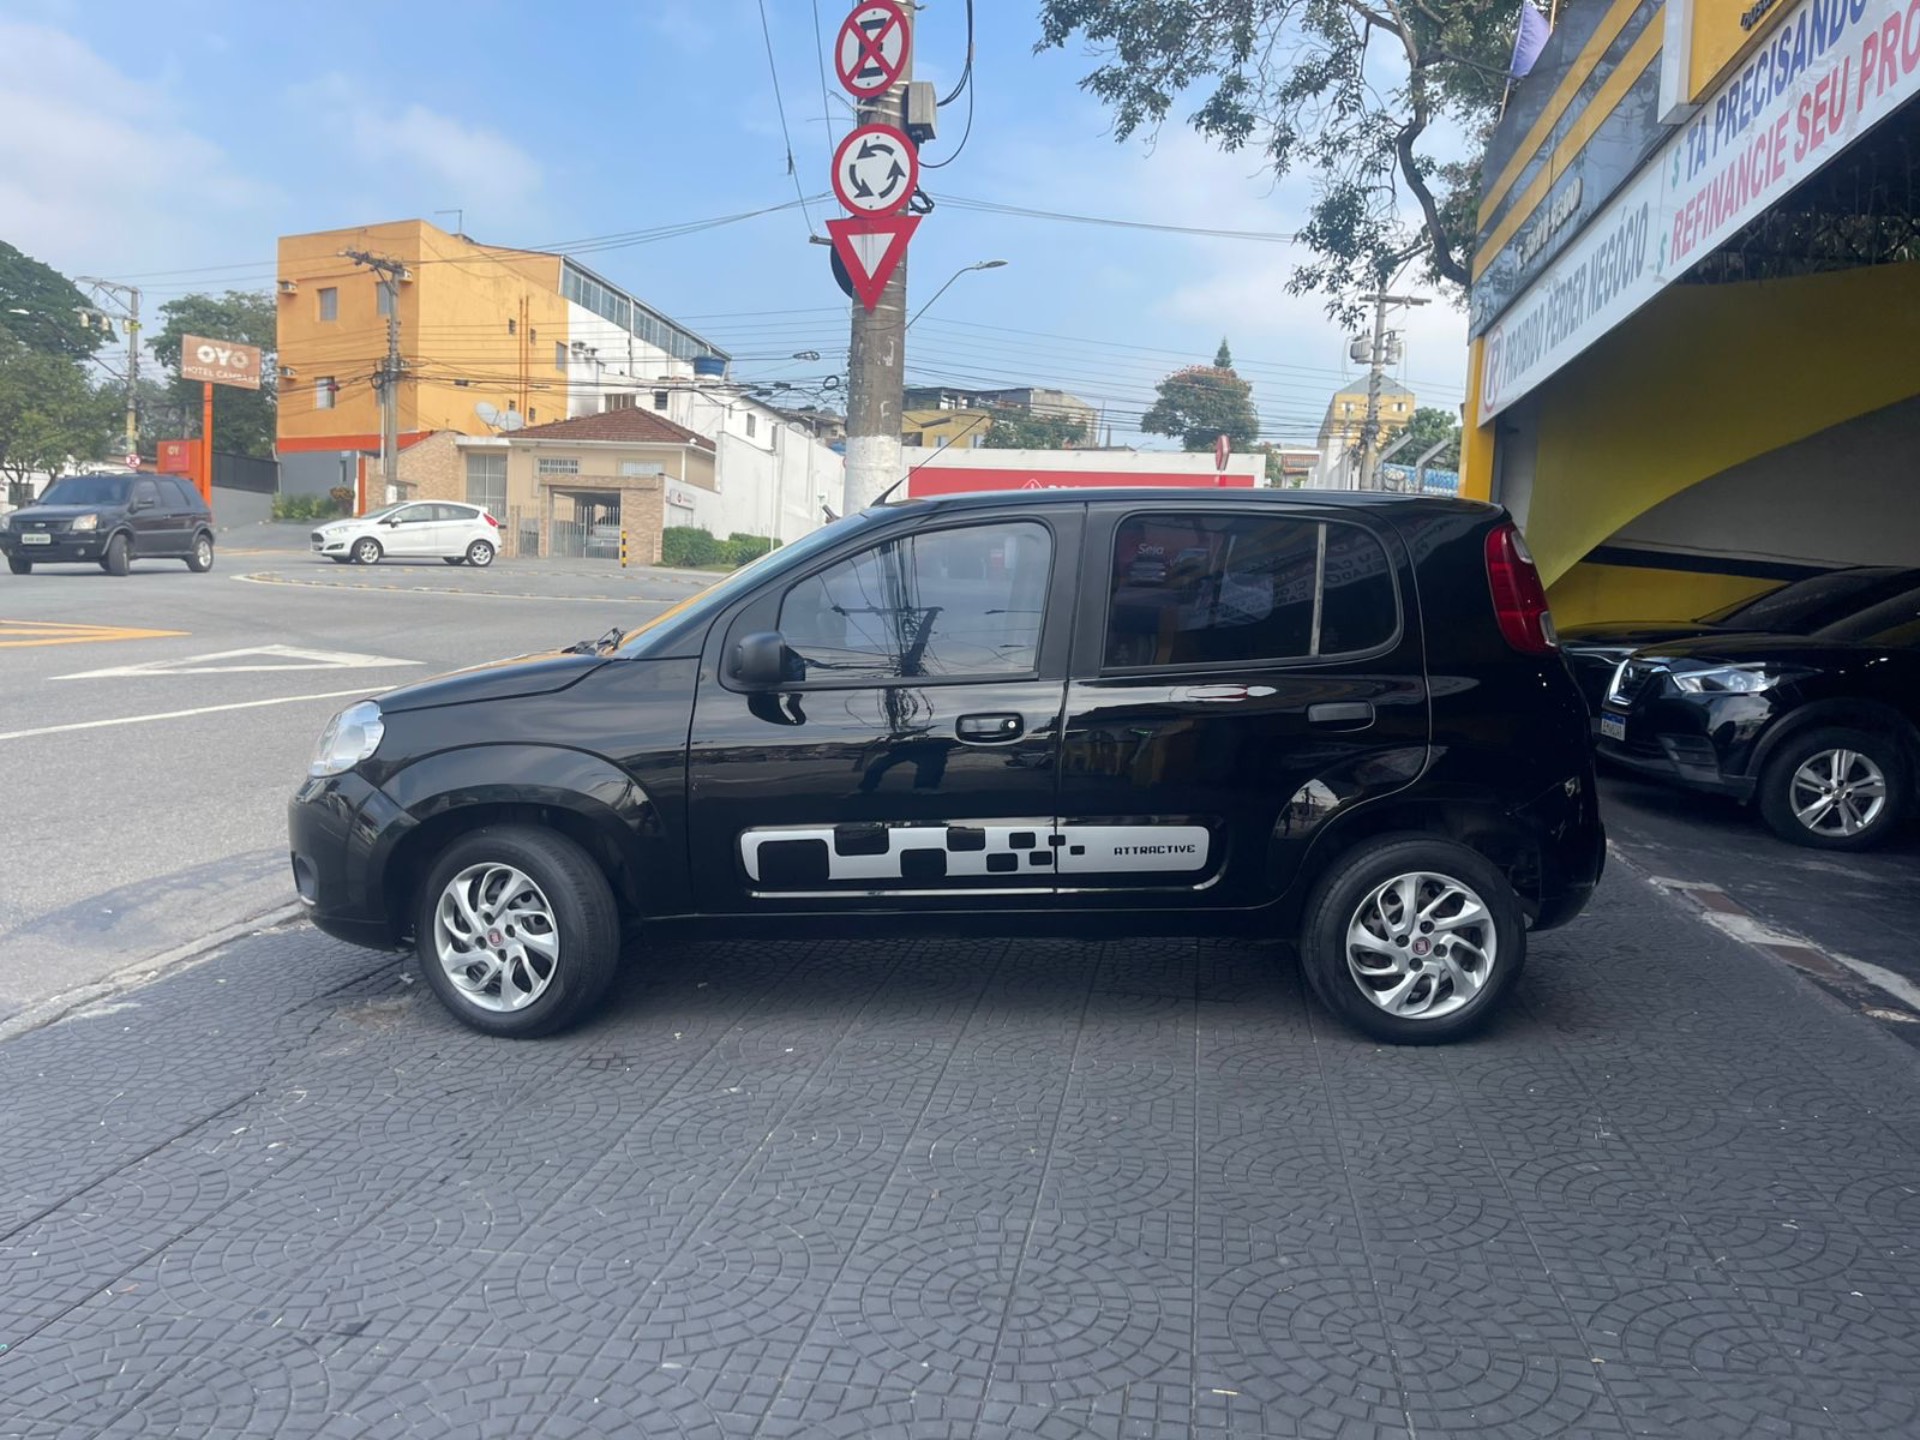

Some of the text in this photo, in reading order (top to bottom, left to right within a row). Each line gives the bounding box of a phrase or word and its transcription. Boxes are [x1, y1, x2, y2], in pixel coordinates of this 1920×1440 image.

[1670, 109, 1790, 266] REFINANCIE
[1794, 55, 1850, 163] SEU
[1587, 201, 1648, 320] NEGÓCIO
[197, 345, 249, 369] OYO
[1114, 844, 1196, 856] ATTRACTIVE
